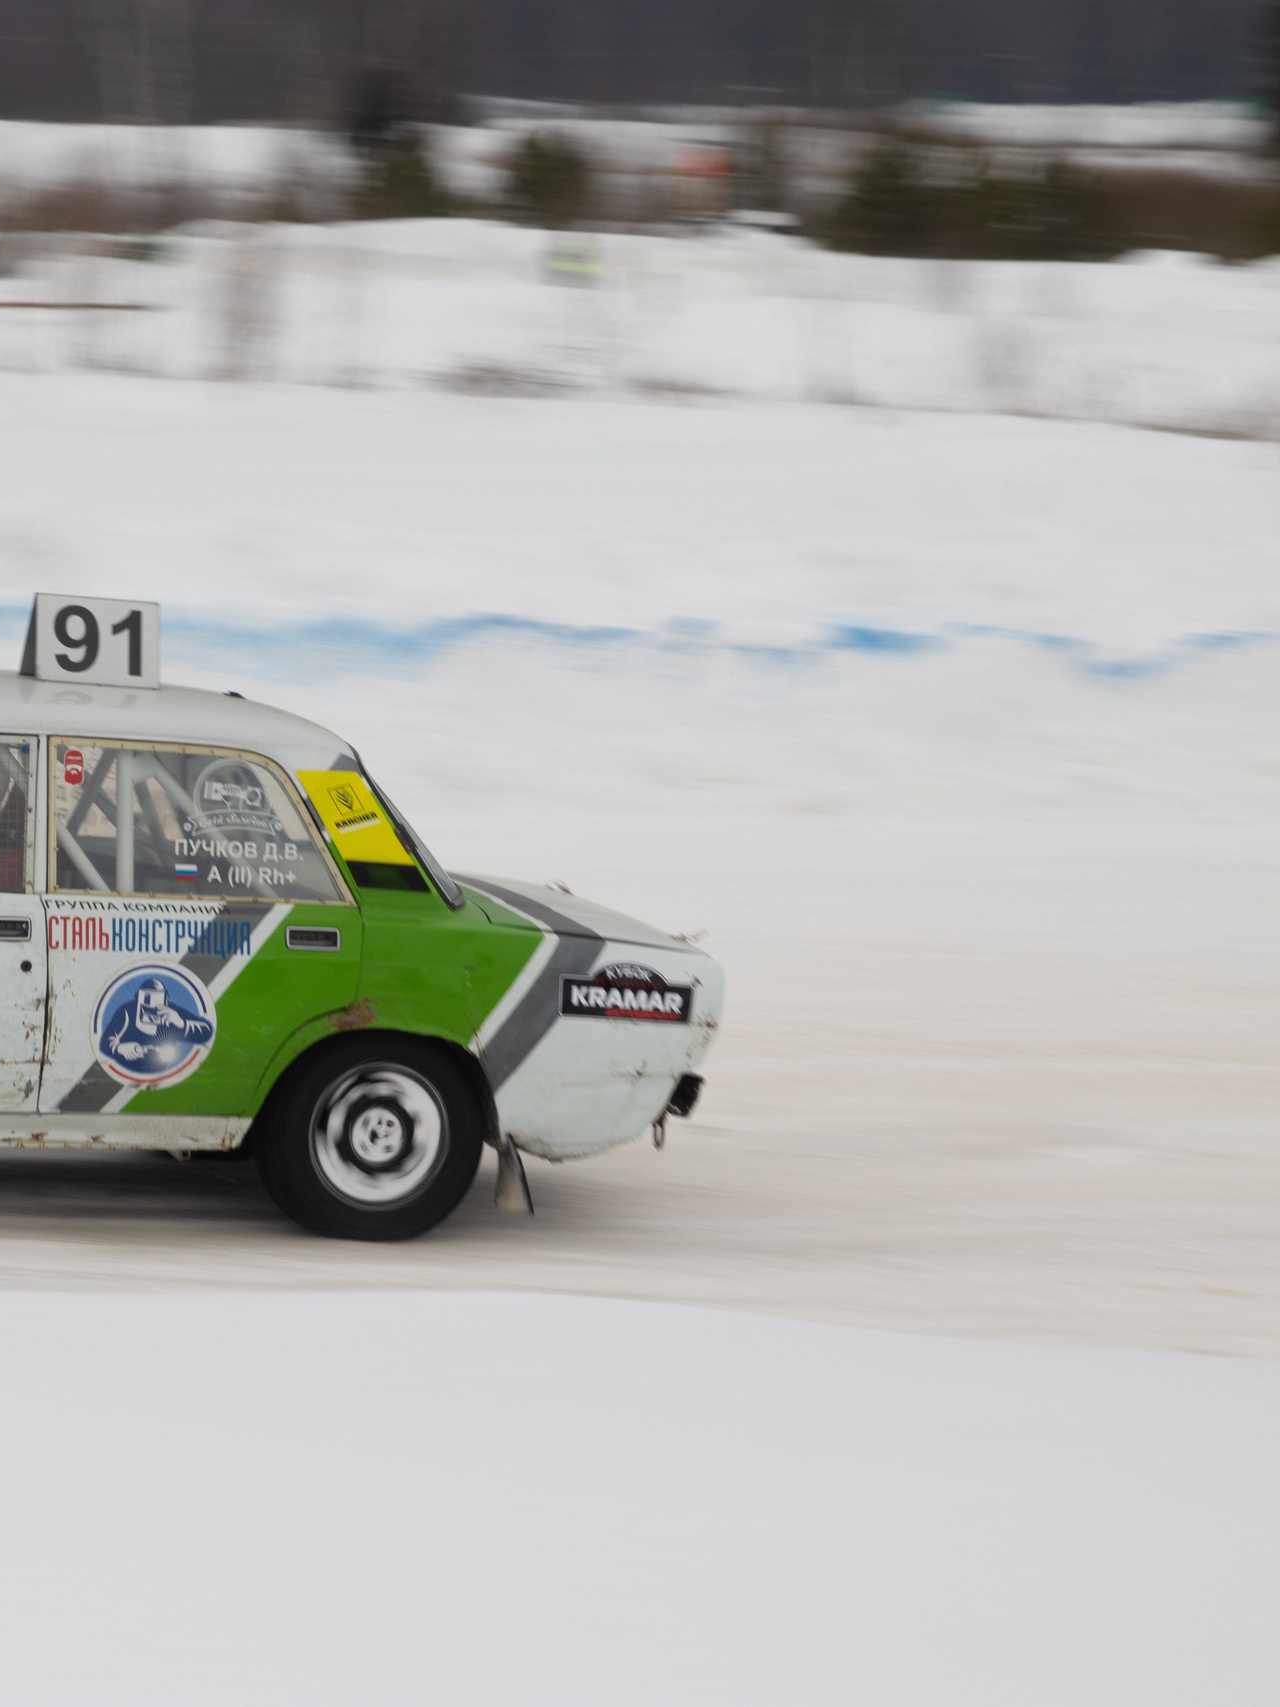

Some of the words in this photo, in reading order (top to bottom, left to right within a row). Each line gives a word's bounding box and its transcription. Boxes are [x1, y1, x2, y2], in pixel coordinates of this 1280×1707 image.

[53, 604, 144, 677] 91
[174, 838, 258, 858] ПУЧКОВ
[263, 841, 304, 863] Д.В.
[227, 865, 252, 889] (II)
[258, 866, 297, 886] Rh+
[44, 900, 119, 911] ГРУППА
[48, 915, 251, 960] СТАЛЬКОНСТРУКЦИЯ
[570, 984, 684, 1015] KRAMAR
